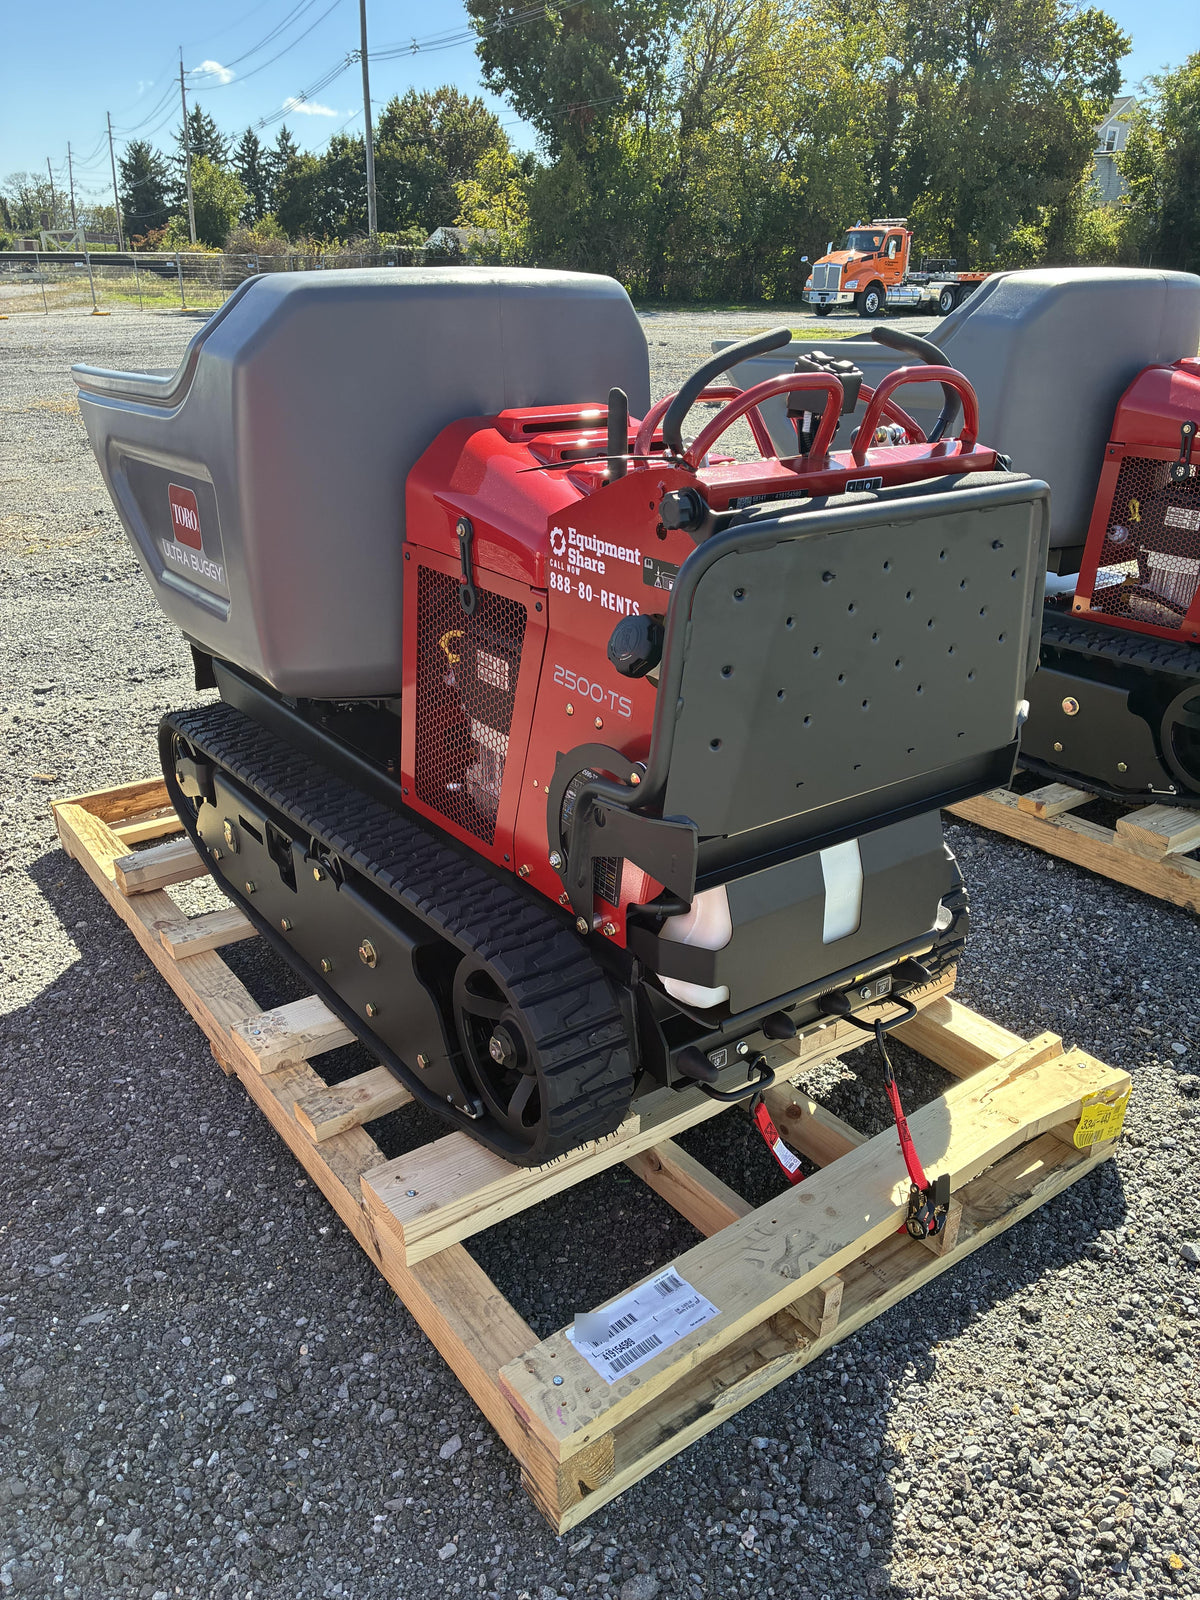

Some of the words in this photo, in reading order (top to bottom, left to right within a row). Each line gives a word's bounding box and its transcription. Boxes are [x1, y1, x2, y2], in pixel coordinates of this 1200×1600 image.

[171, 503, 197, 531] TORO
[161, 537, 191, 569] ULTRA
[190, 554, 223, 582] BUGGY
[567, 526, 641, 566] Equipment
[567, 547, 606, 575] Share
[549, 558, 565, 571] CALL
[566, 564, 581, 576] NOW
[549, 571, 640, 616] 888-80-RENTS
